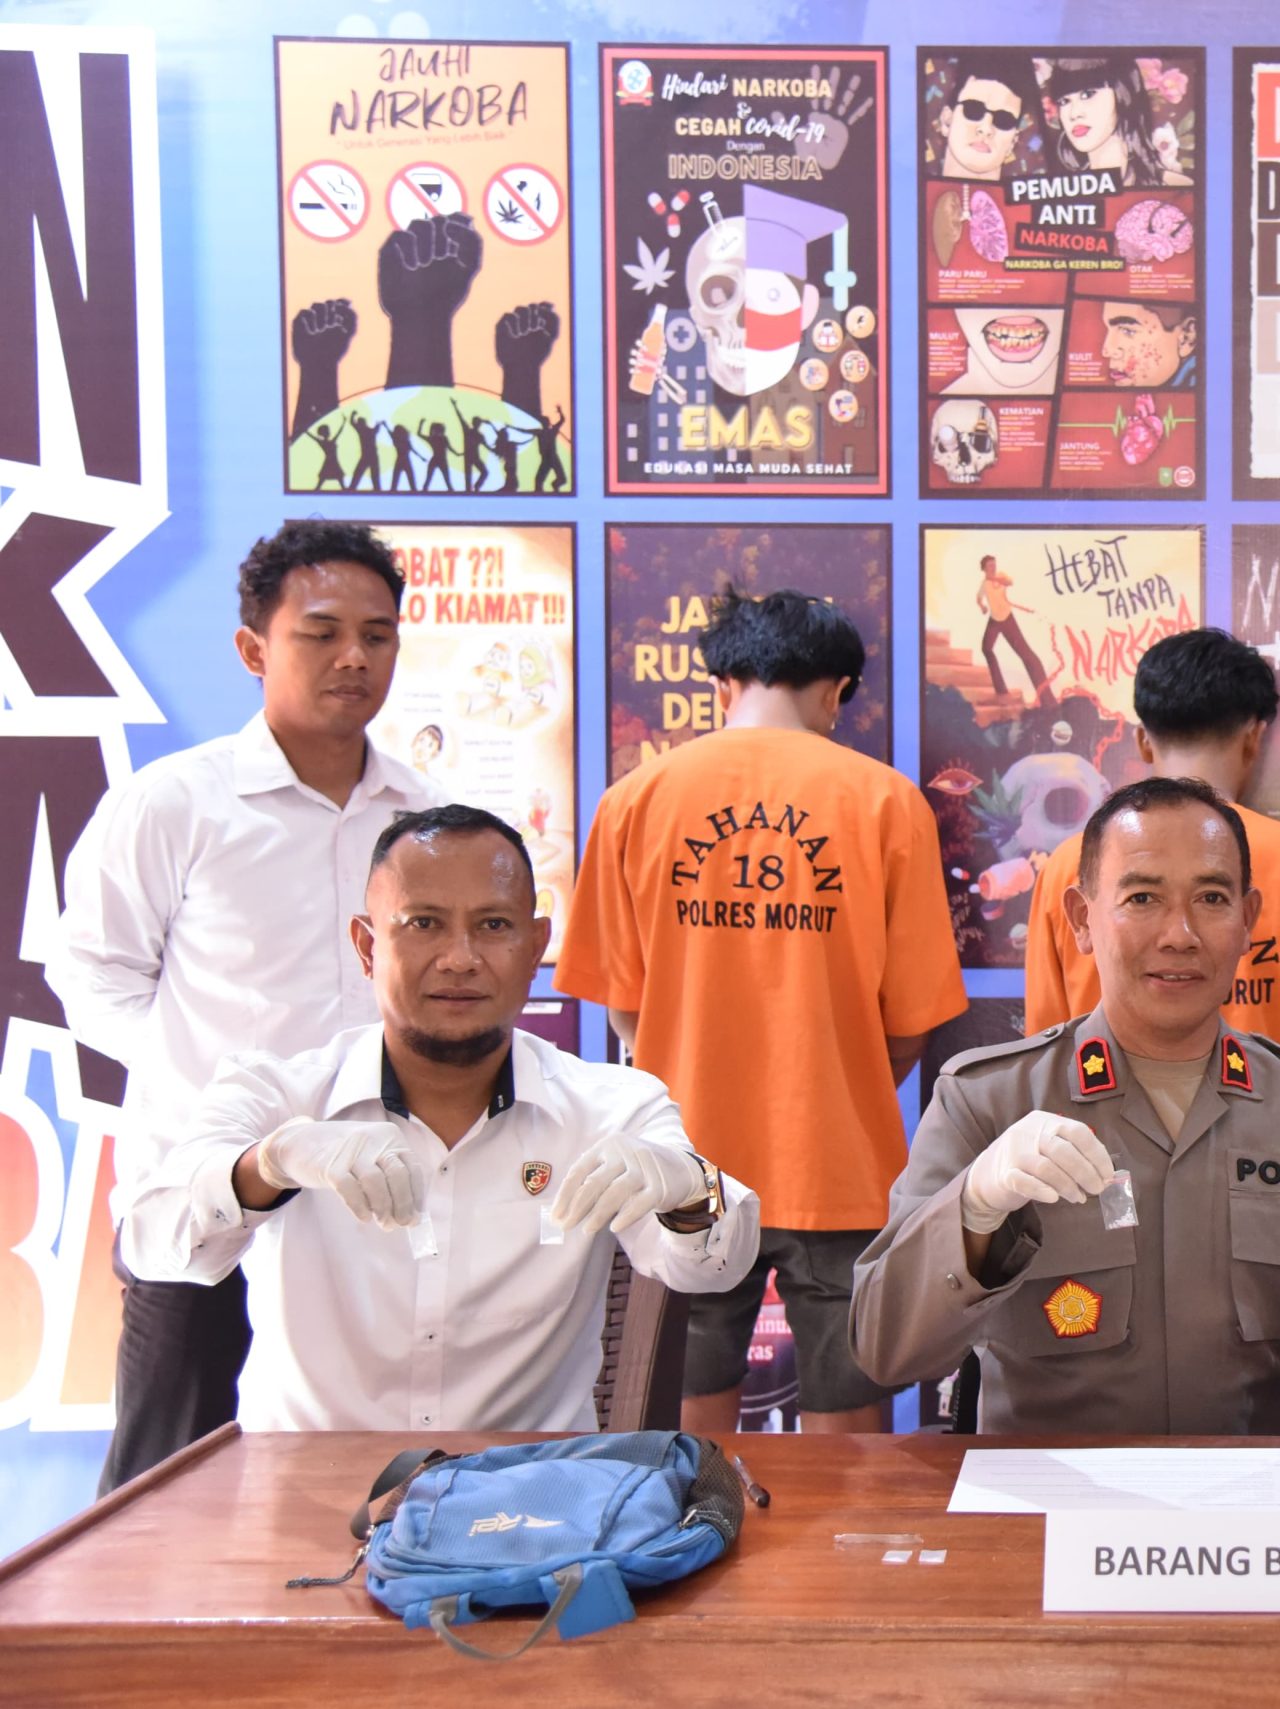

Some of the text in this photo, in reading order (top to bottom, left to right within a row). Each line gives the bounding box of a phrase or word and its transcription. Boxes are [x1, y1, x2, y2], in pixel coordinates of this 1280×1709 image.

[379, 45, 471, 82] JAUHI
[661, 72, 833, 100] Hindari NARKOBA
[330, 81, 527, 135] NARKOBA
[675, 118, 741, 135] CEGAH
[726, 140, 765, 153] Dengan
[668, 154, 823, 180] INDONESIA
[1012, 173, 1116, 201] PEMUDA
[1038, 205, 1096, 225] ANTI
[1019, 229, 1109, 252] NARKOBA
[1005, 260, 1051, 269] NARKOBA
[681, 405, 815, 450] EMAS
[644, 462, 853, 474] EDUKASI MASA MUDA SEHAT
[1044, 535, 1128, 596] HEBAT
[435, 593, 539, 624] KIAMAT
[1097, 573, 1176, 619] TANPA
[672, 801, 843, 893] TAHANAN
[733, 855, 784, 891] 18
[676, 900, 837, 932] POLRES MORUT
[1223, 978, 1275, 1005] RUT
[1093, 1546, 1252, 1577] BARANG
